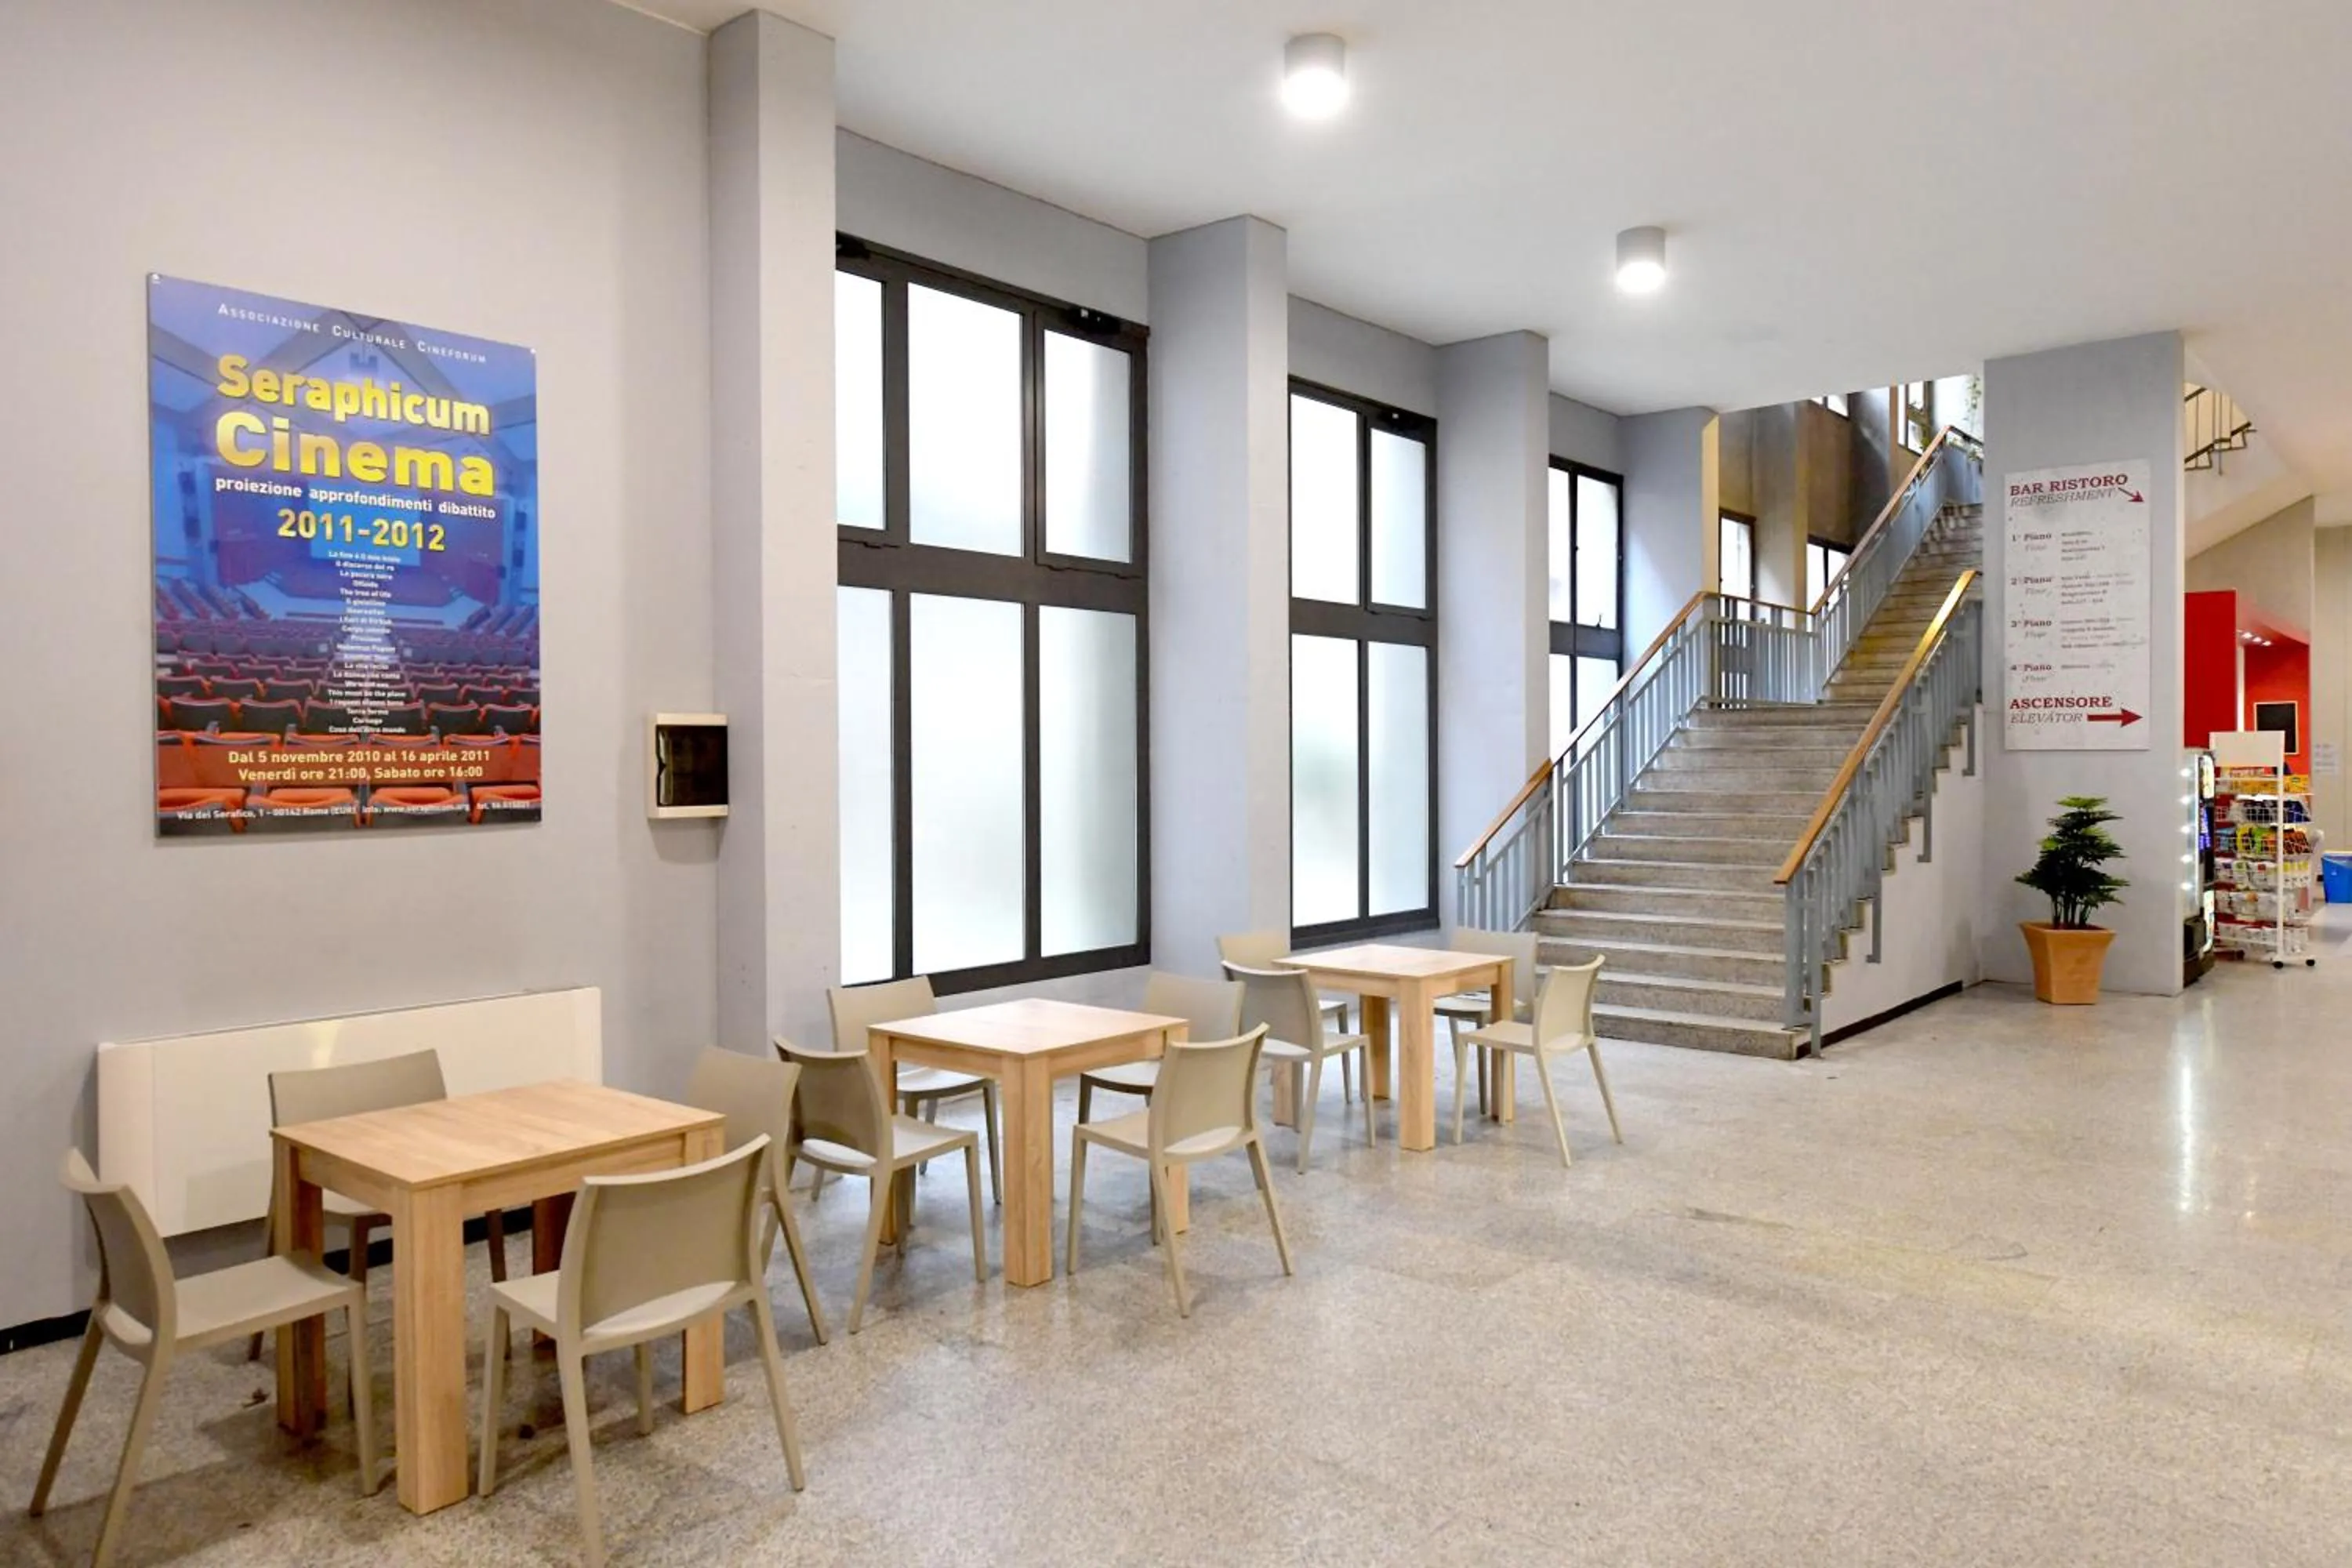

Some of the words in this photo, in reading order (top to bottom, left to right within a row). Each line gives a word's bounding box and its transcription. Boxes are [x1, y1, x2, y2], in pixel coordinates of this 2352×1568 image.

[216, 351, 491, 435] Seraphicum
[216, 412, 495, 496] Cinema
[2009, 481, 2044, 496] BAR
[2049, 473, 2129, 492] RISTORO
[216, 477, 303, 498] proiezione
[309, 488, 433, 513] approfondimenti
[438, 501, 496, 519] dibattito
[277, 508, 446, 552] 2011-2012
[2009, 695, 2113, 710] ASCENSORE
[2010, 712, 2083, 724] ELEVATOR
[228, 750, 254, 764] Dal
[258, 750, 268, 763] 5
[271, 750, 343, 764] novembre
[347, 750, 380, 763] 2010
[383, 750, 397, 762] al
[401, 750, 416, 762] 16
[419, 750, 459, 764] aprile
[461, 750, 490, 762] 2011
[299, 770, 325, 780] ore
[374, 767, 421, 779] Sabato
[423, 768, 446, 778] ore
[450, 765, 484, 778] 16:00
